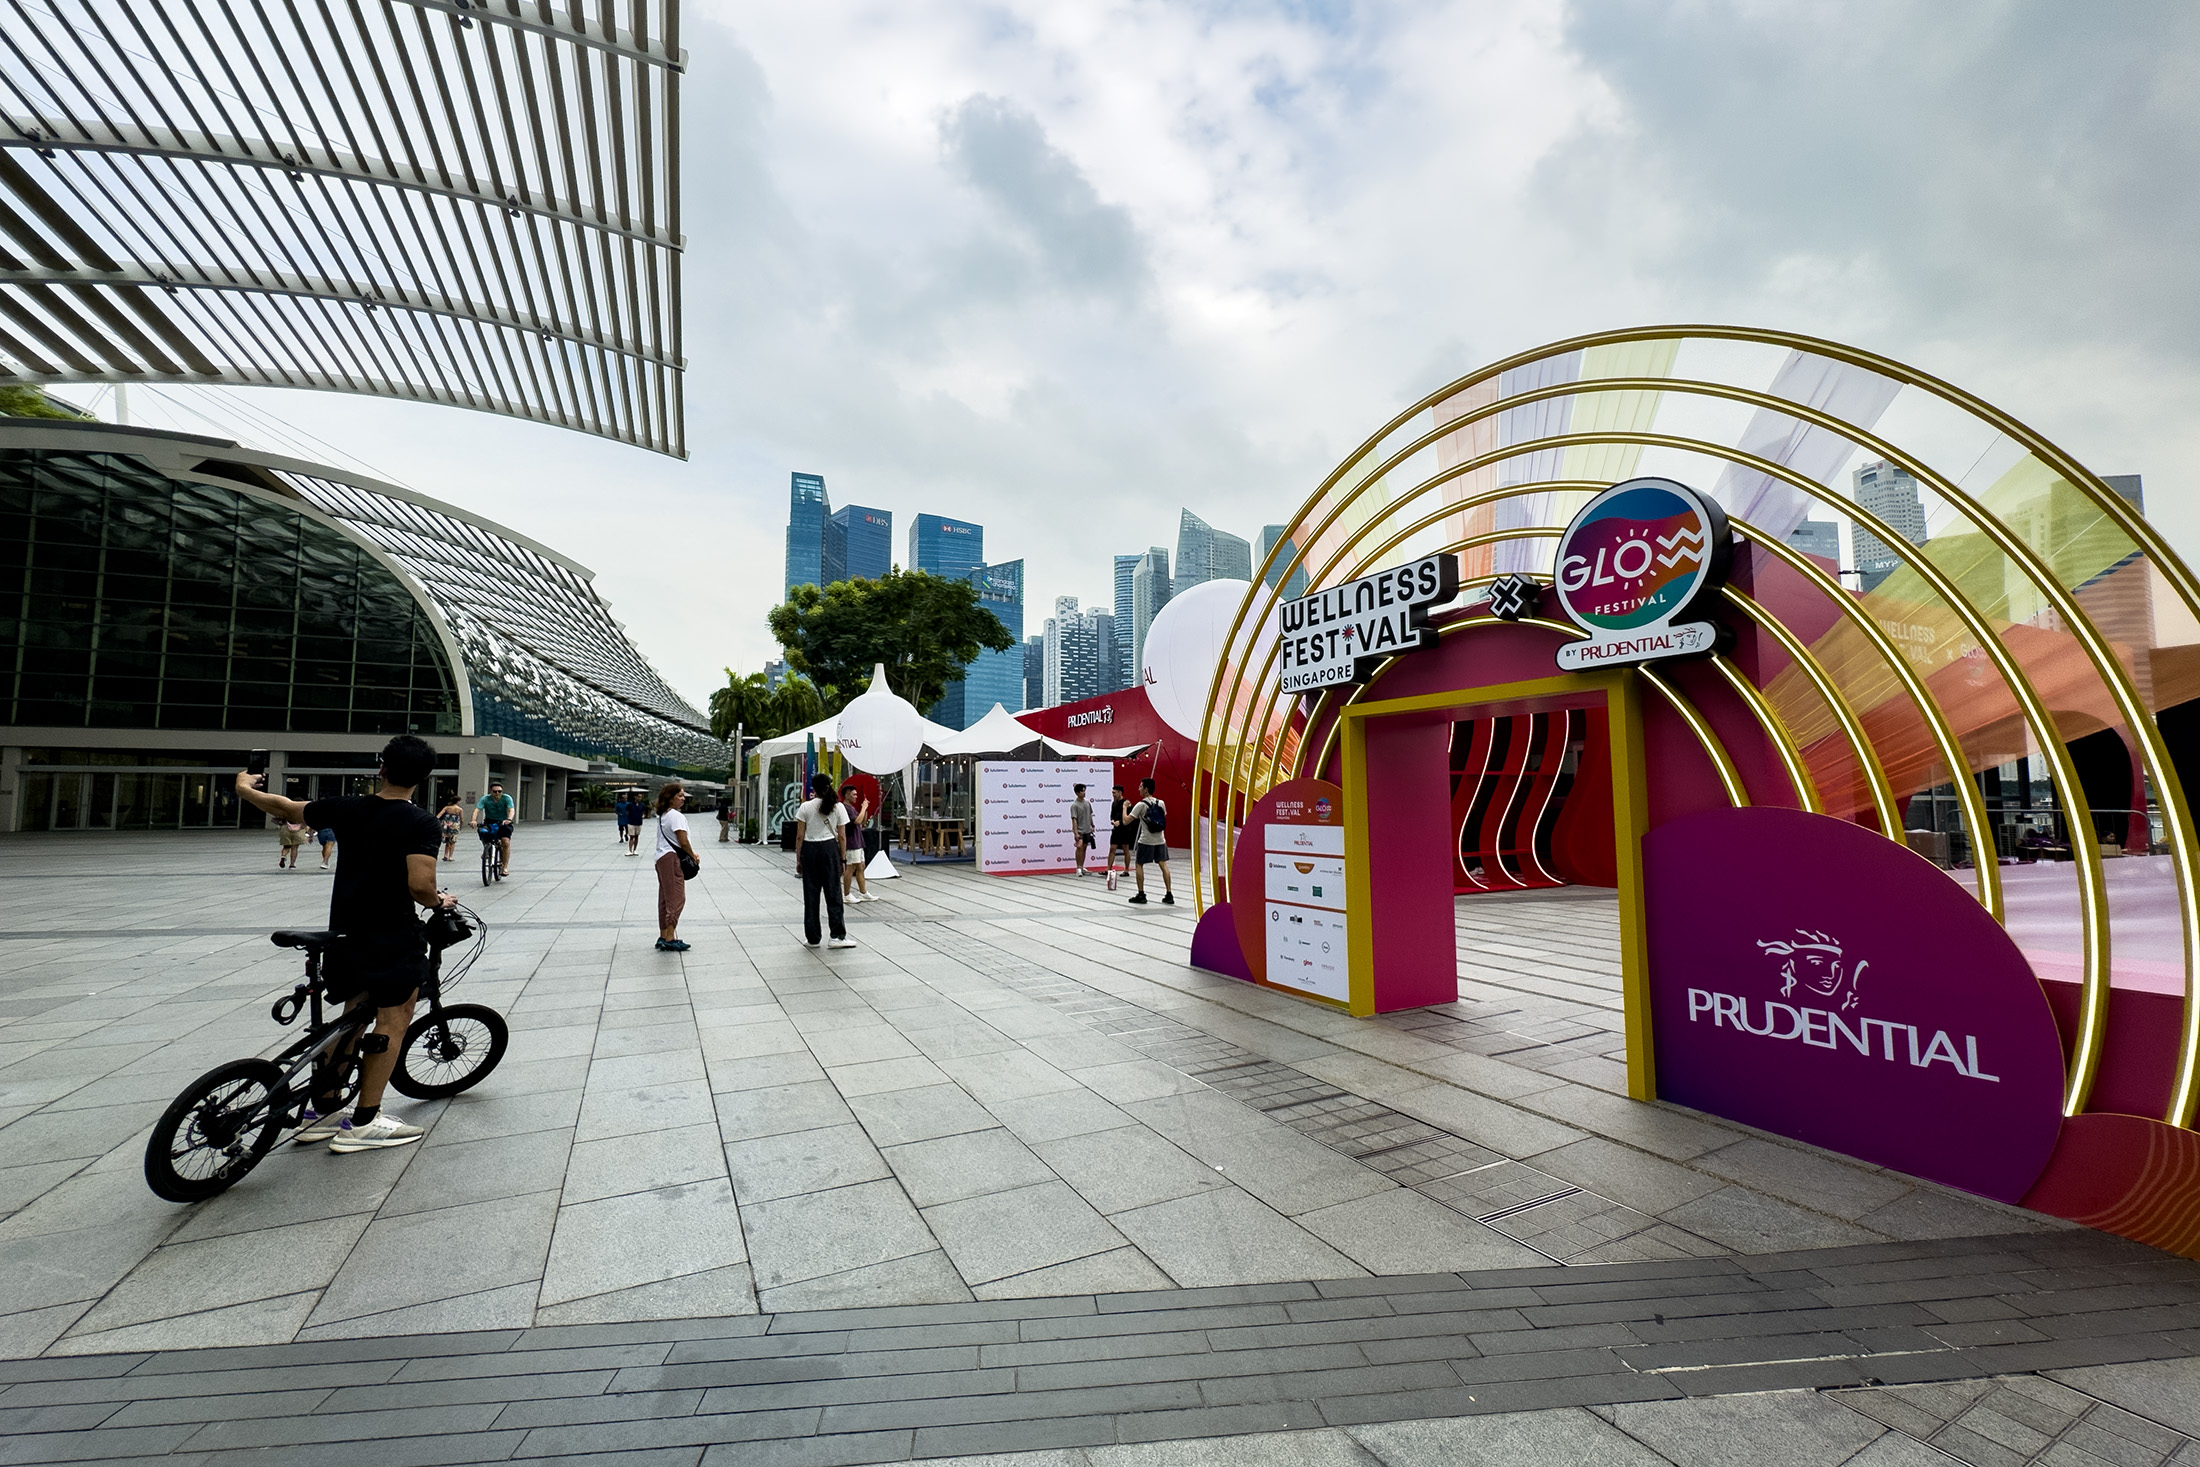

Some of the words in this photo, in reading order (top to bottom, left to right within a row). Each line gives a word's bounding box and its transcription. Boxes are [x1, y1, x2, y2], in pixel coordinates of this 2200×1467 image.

[872, 516, 889, 527] DBS
[953, 527, 972, 535] HSBC
[1561, 526, 1704, 592] GLOW
[1282, 561, 1437, 634] WELLNESS
[1595, 594, 1667, 616] FESTIVAL
[1566, 649, 1577, 657] BY
[1581, 635, 1674, 661] PRUDENTIAL
[1283, 664, 1352, 690] SINGAPORE
[1067, 709, 1103, 729] PRUDENTIAL
[1276, 801, 1303, 809] WELLNESS
[1688, 987, 1999, 1083] PRUDENTIAL
